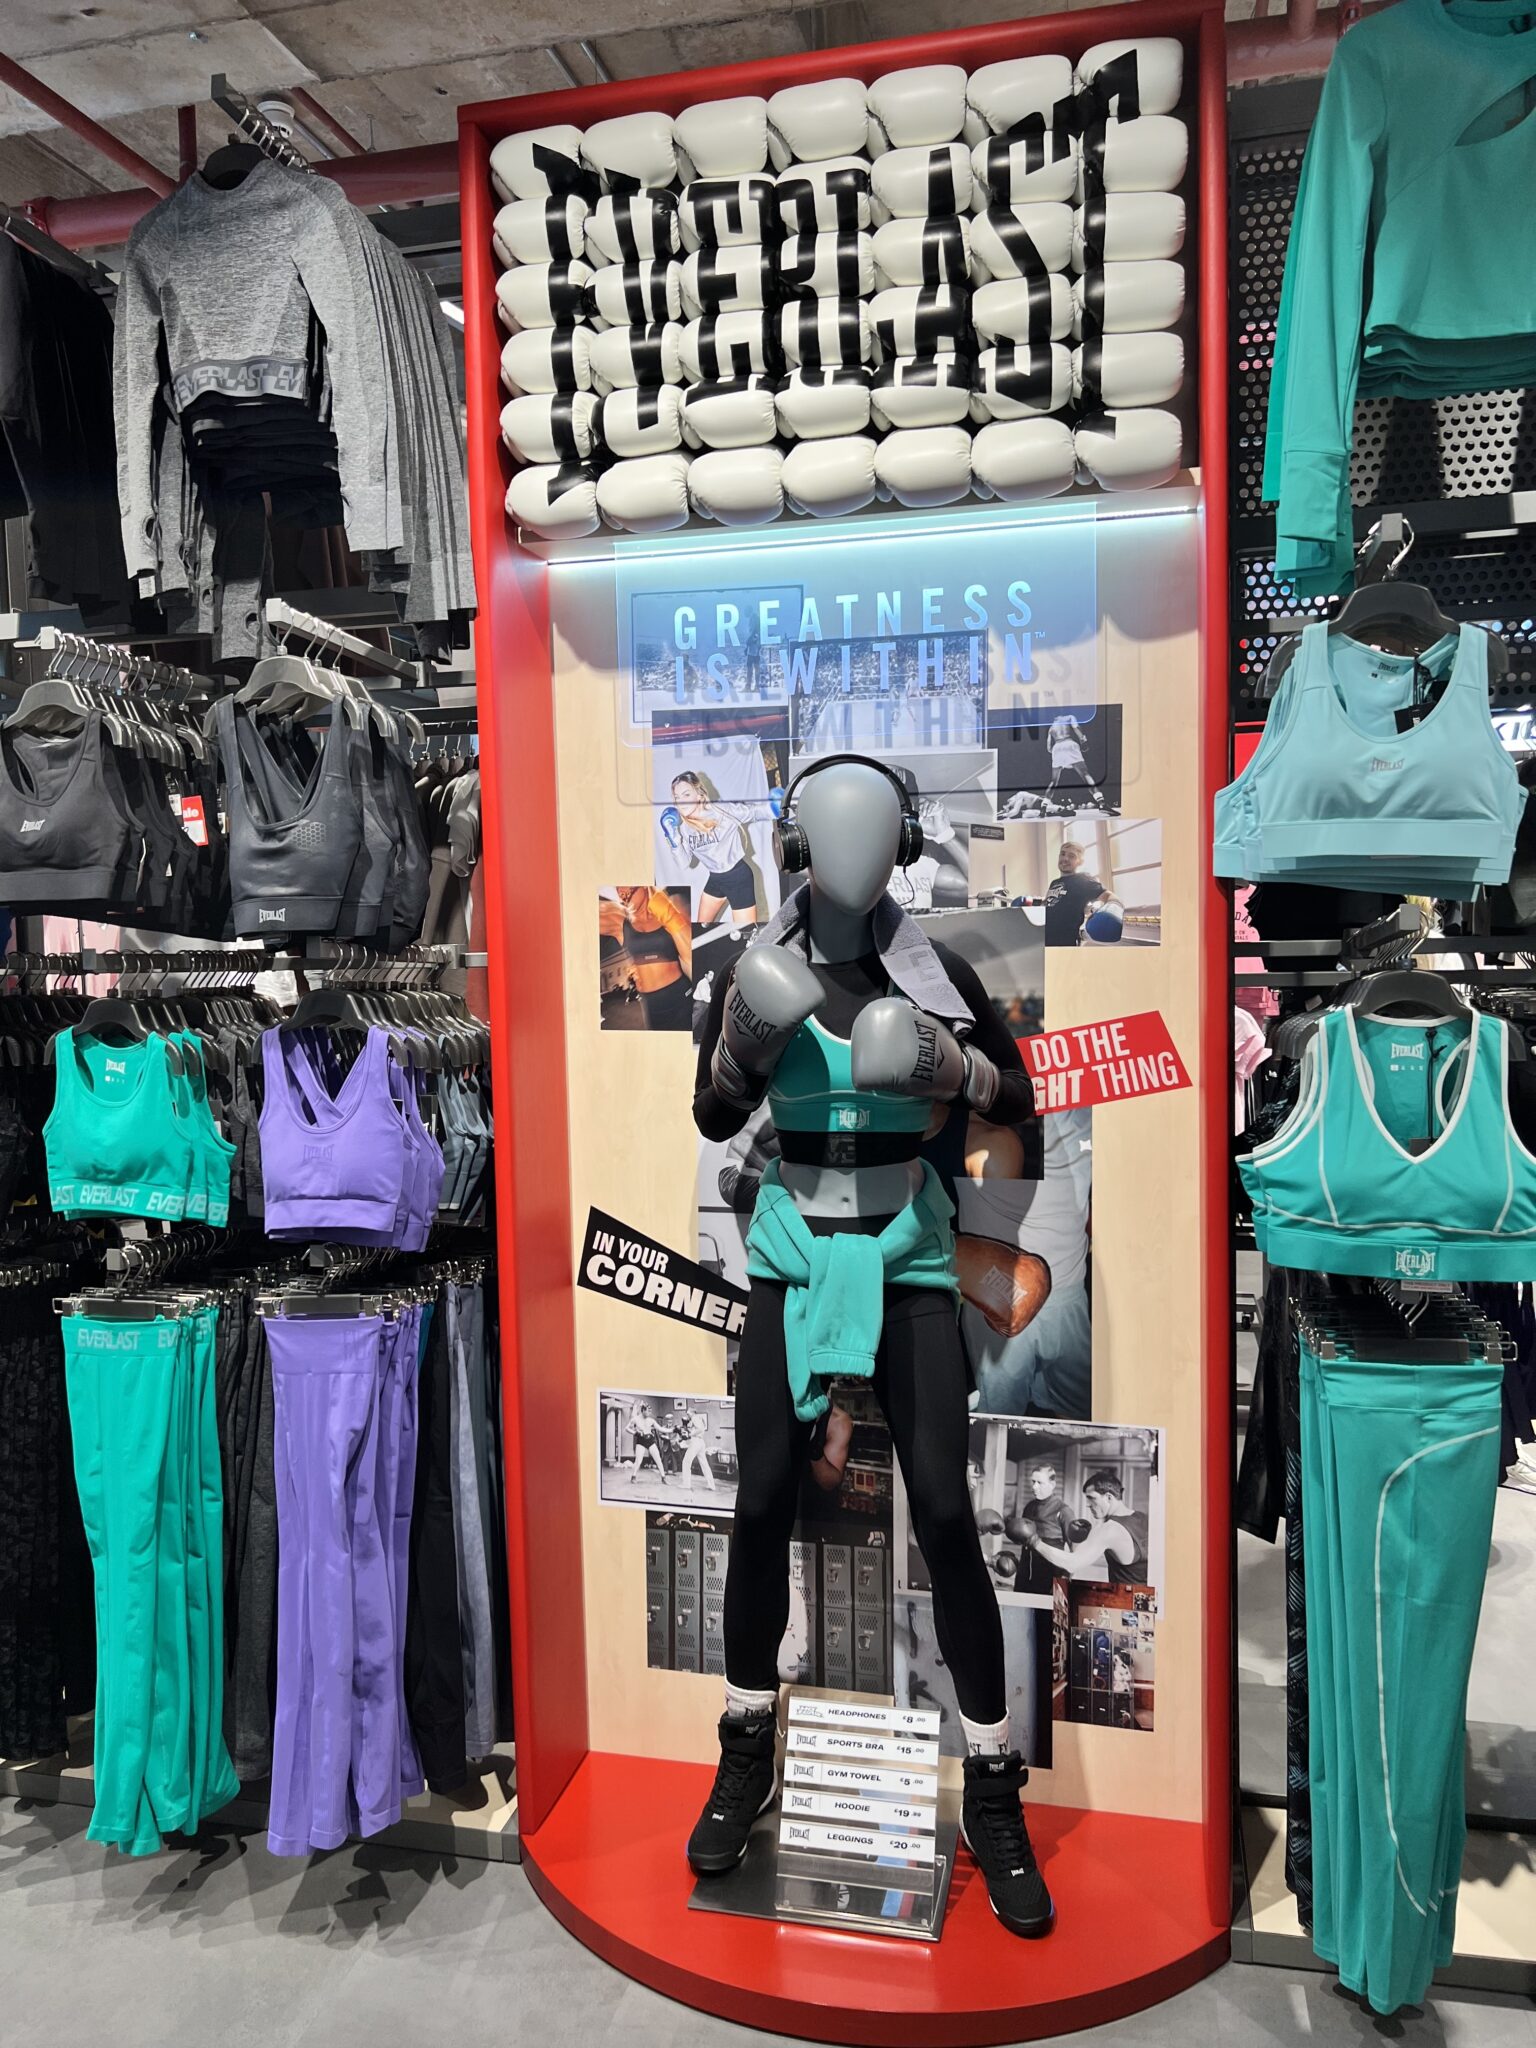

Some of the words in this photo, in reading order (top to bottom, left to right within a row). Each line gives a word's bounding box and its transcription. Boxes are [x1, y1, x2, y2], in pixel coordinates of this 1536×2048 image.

[532, 48, 1141, 507] EVERLAST
[673, 580, 1032, 651] GREATNESS
[675, 653, 730, 702] IS
[779, 632, 1032, 696] WITHIN
[258, 907, 286, 924] EVERLAST
[728, 987, 778, 1044] EVERLAST
[910, 1020, 937, 1083] EVERLAST
[1029, 1034, 1071, 1073] DO
[1072, 1022, 1130, 1064] THE
[1391, 1042, 1424, 1060] EVERLAST
[1091, 1051, 1180, 1098] THING
[79, 1184, 140, 1209] EVERLAST
[592, 1230, 615, 1254] IN
[619, 1238, 669, 1274] YOUR
[77, 1328, 140, 1351] EVERLAST
[828, 1708, 887, 1721] HEADPHONES
[796, 1733, 817, 1748] EVERLAST
[827, 1738, 863, 1749] SPORTS
[865, 1742, 884, 1751] BRA
[793, 1763, 815, 1778] EVERLAST
[827, 1769, 848, 1778] GYM
[850, 1772, 882, 1782] TOWEL
[791, 1795, 813, 1809] EVERLAST
[834, 1802, 871, 1812] HOODIE
[789, 1826, 811, 1841] EVERLAST
[827, 1832, 874, 1845] LEGGINGS
